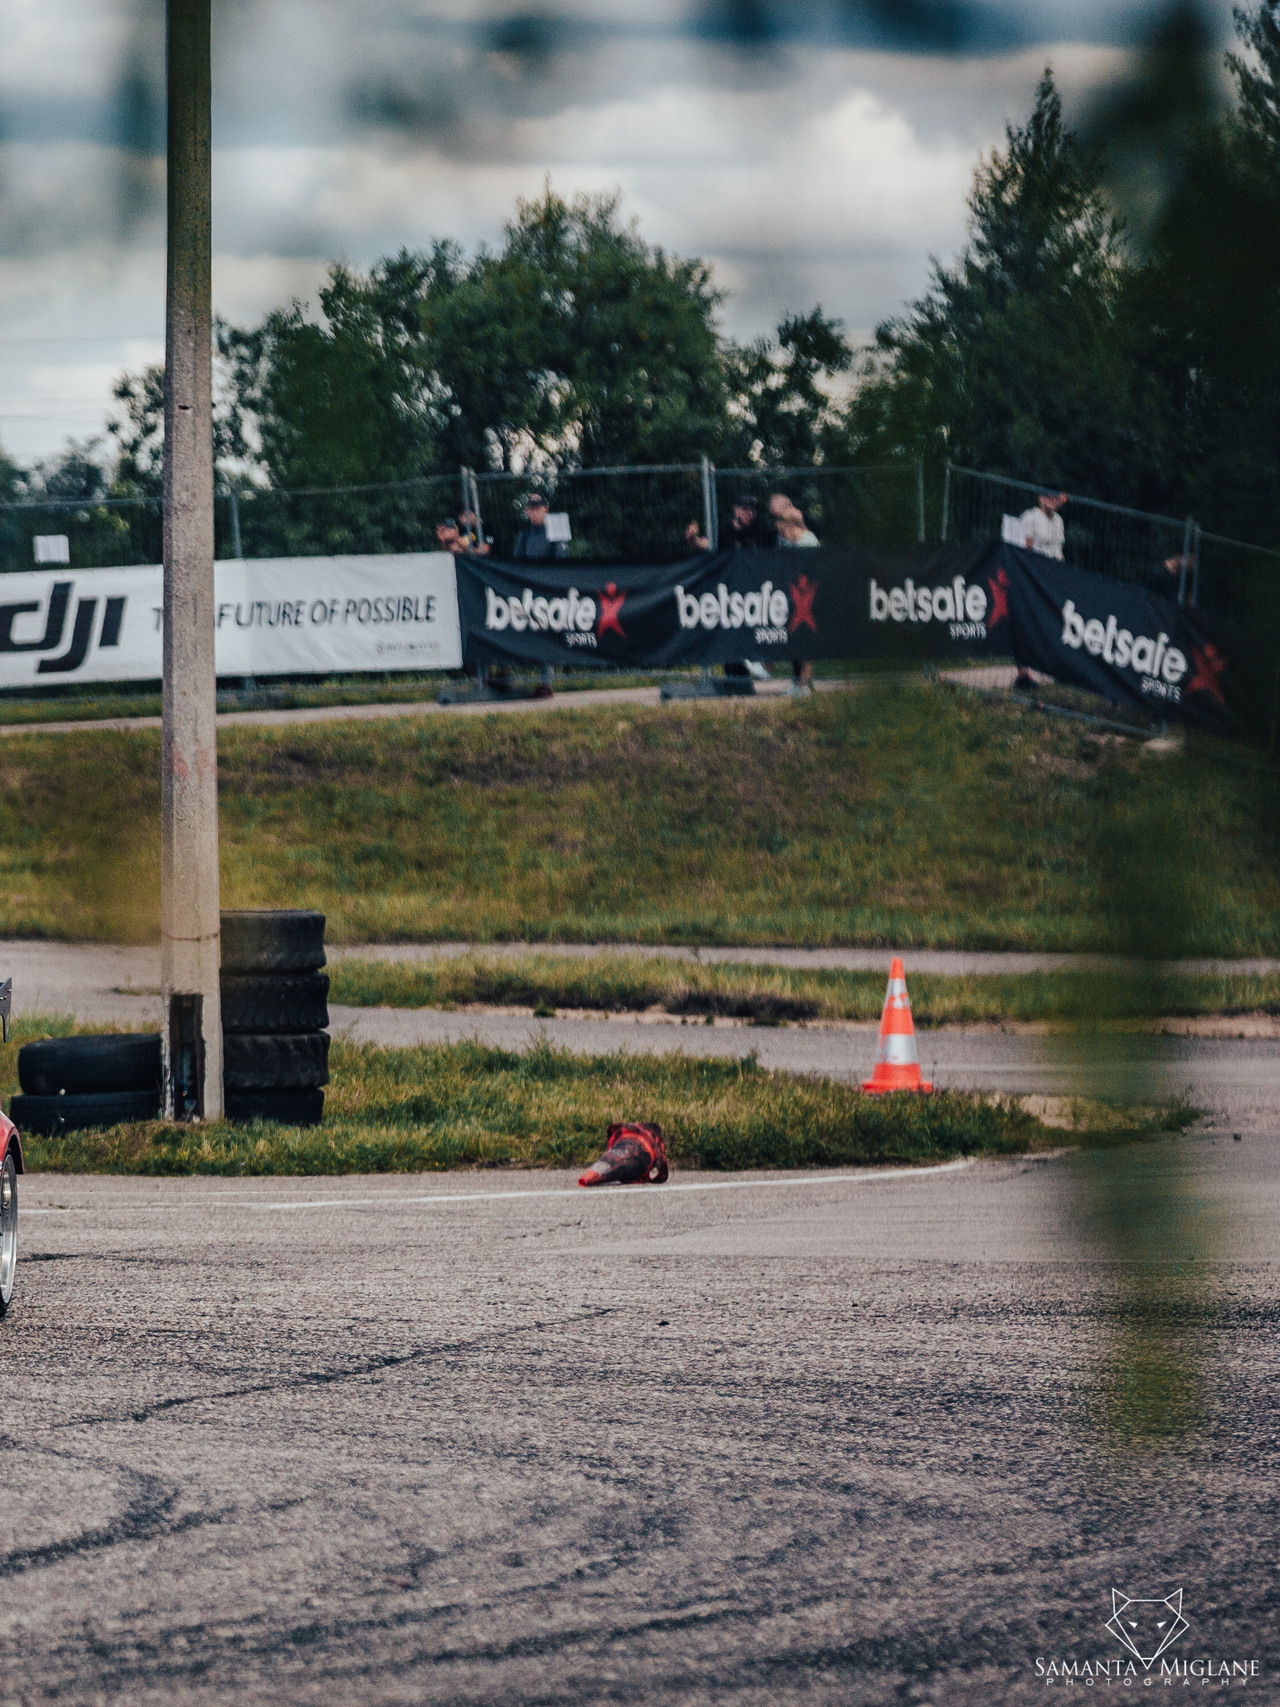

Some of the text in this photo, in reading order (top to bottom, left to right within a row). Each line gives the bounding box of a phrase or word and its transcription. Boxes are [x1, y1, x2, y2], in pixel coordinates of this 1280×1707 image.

[216, 595, 437, 628] FUTURE OF POSSIBLE
[485, 586, 597, 632] betsafe
[674, 580, 789, 630] betsafe
[870, 575, 987, 622] betsafe
[566, 632, 597, 648] SPORTS
[754, 626, 788, 645] SPORTS
[948, 621, 987, 640] SPORTS
[1061, 599, 1188, 683] betsafe
[1140, 675, 1181, 703] SPORTS
